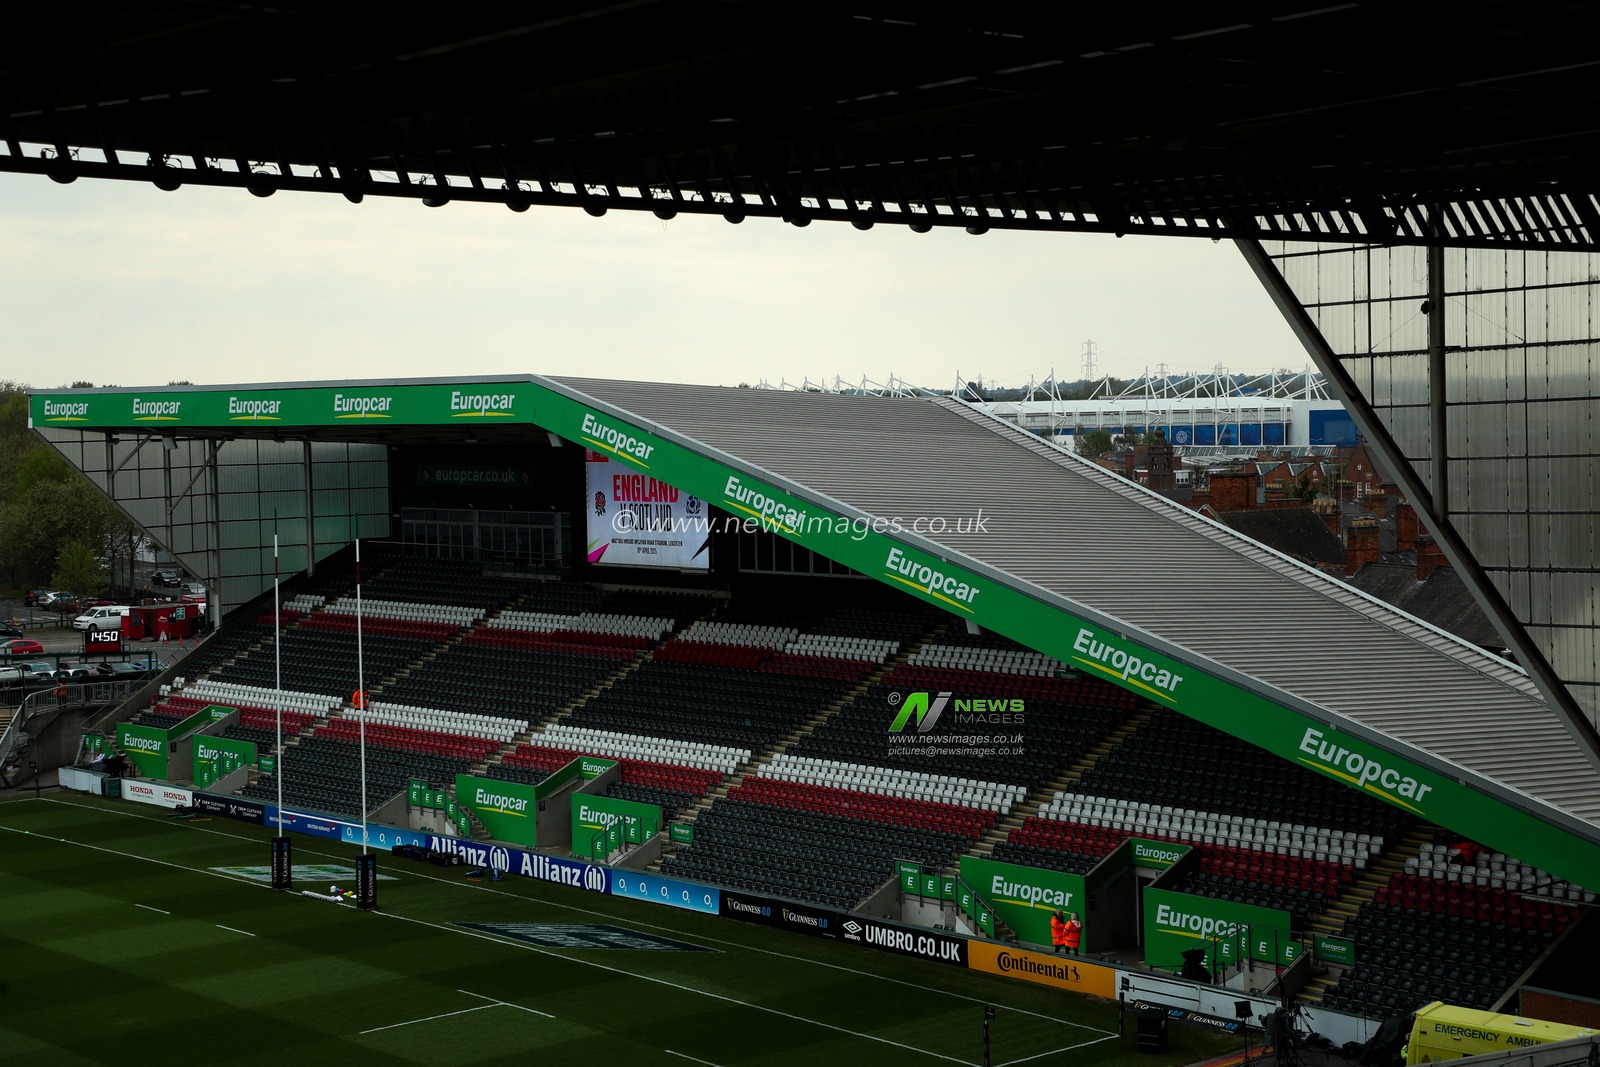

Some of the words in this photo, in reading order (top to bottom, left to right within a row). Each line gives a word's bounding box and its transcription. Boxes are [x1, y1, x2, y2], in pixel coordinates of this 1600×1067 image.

[44, 400, 88, 421] Europcar
[132, 398, 181, 420] Europcar
[228, 396, 281, 420] Europcar
[333, 394, 392, 418] Europcar
[451, 391, 515, 416] Europcar
[581, 413, 654, 460] Europcar
[436, 468, 515, 484] europcar.co.uk
[613, 474, 678, 503] ENGLAND
[724, 476, 806, 528] Europcar
[886, 547, 980, 603] Europcar
[91, 631, 118, 642] 14:50
[1073, 628, 1183, 692] Europcar
[124, 732, 162, 753] Europcar
[198, 744, 239, 760] Euroar
[1298, 726, 1433, 802] Europcar
[130, 786, 154, 795] HONDA
[164, 792, 187, 801] HONDA
[412, 791, 417, 799] E
[436, 794, 443, 802] E
[476, 788, 528, 813] Europcar
[449, 804, 453, 812] E
[461, 818, 466, 826] E
[610, 832, 615, 840] E
[630, 828, 635, 836] E
[396, 836, 402, 846] O
[596, 842, 602, 850] E
[431, 836, 487, 868] Allianz
[1135, 844, 1182, 862] Europca
[520, 852, 581, 887] Allianz
[619, 878, 627, 892] O2
[907, 877, 914, 886] E
[928, 880, 934, 890] E
[944, 882, 952, 892] E
[640, 882, 648, 896] O2
[661, 886, 669, 899] O2
[992, 875, 1073, 908] Europcar
[682, 890, 691, 903] O2
[704, 894, 712, 908] O2
[962, 895, 969, 904] E
[733, 901, 761, 915] GUINNESS
[762, 906, 771, 917] 0.0
[788, 912, 818, 926] GUINNESS
[818, 917, 828, 928] 0.0
[980, 913, 987, 923] E
[844, 933, 860, 941] umbro
[865, 924, 960, 962] UMBRO.CO.UK
[1222, 943, 1230, 954] E
[1259, 942, 1267, 952] E
[1286, 946, 1293, 957] E
[1321, 942, 1347, 952] Europcar
[997, 952, 1070, 981] Continental
[1193, 1016, 1226, 1028] GUINNESS
[1434, 1023, 1500, 1042] EMERGENCY
[1506, 1035, 1542, 1048] AMBU
